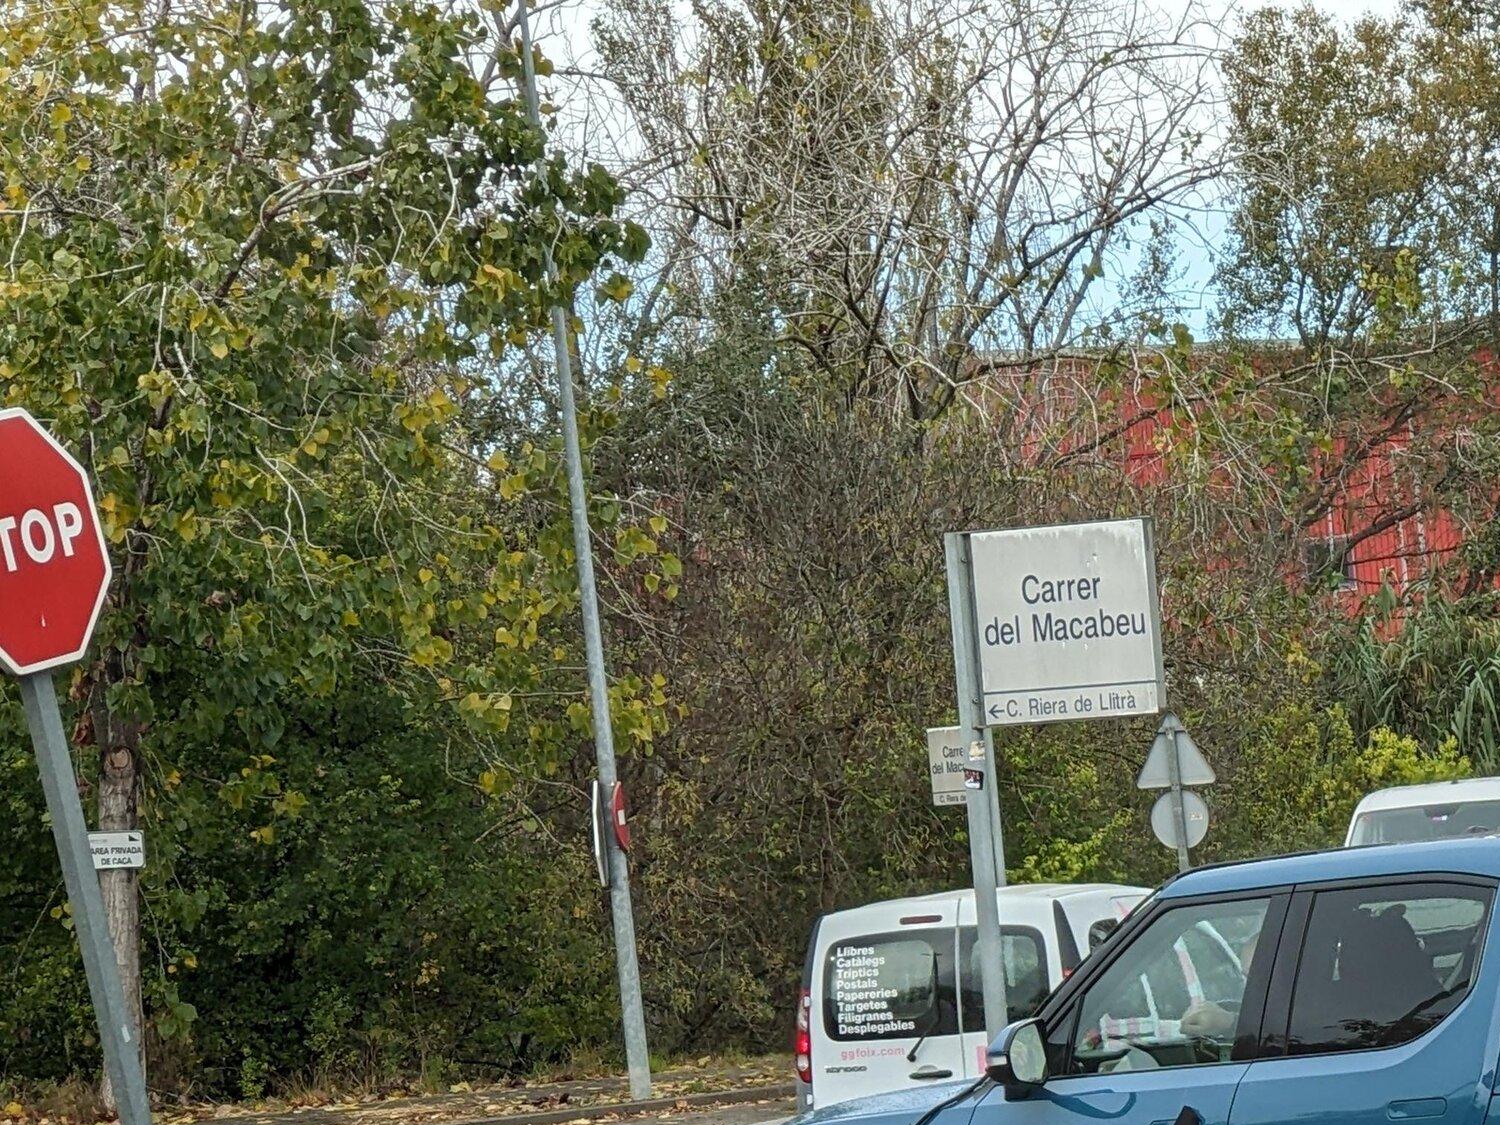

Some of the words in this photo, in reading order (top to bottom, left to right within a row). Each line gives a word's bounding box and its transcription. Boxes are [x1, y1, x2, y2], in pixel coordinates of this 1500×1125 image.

[0, 502, 83, 572] TOP
[1021, 574, 1101, 605] Carrer
[984, 615, 1021, 646] del
[1032, 608, 1146, 643] Macabeu
[1006, 699, 1023, 718] C.
[1028, 697, 1068, 716] Riera
[1074, 695, 1092, 713] de
[1099, 690, 1137, 711] Llitrà
[942, 745, 964, 759] Carre
[837, 979, 878, 989] Postals
[837, 988, 898, 1002] Papereries
[837, 1001, 888, 1013] Targetes
[838, 1011, 894, 1024] Filigranes
[839, 1020, 915, 1035] Desplegables
